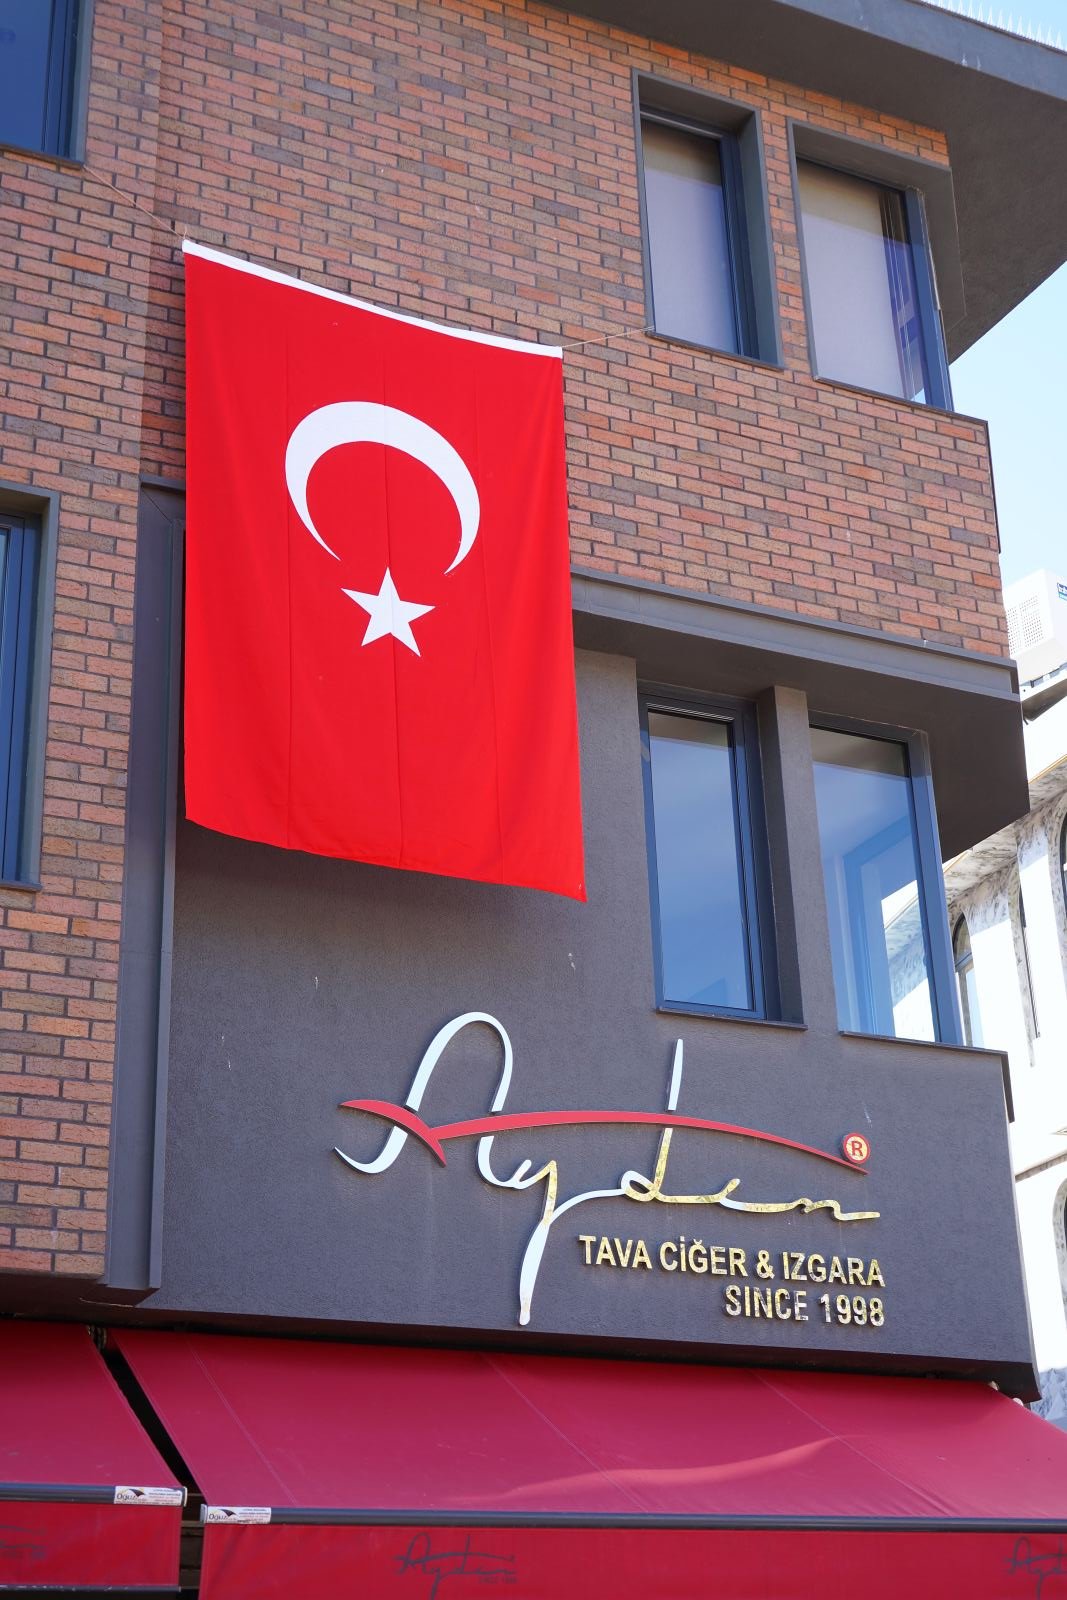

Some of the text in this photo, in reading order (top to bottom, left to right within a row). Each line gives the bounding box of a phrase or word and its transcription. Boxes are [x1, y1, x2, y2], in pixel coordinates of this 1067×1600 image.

[579, 1235, 652, 1269] TAVA
[756, 1250, 775, 1279] &
[782, 1252, 886, 1287] IZGARA
[725, 1285, 885, 1327] SINCE 1998
